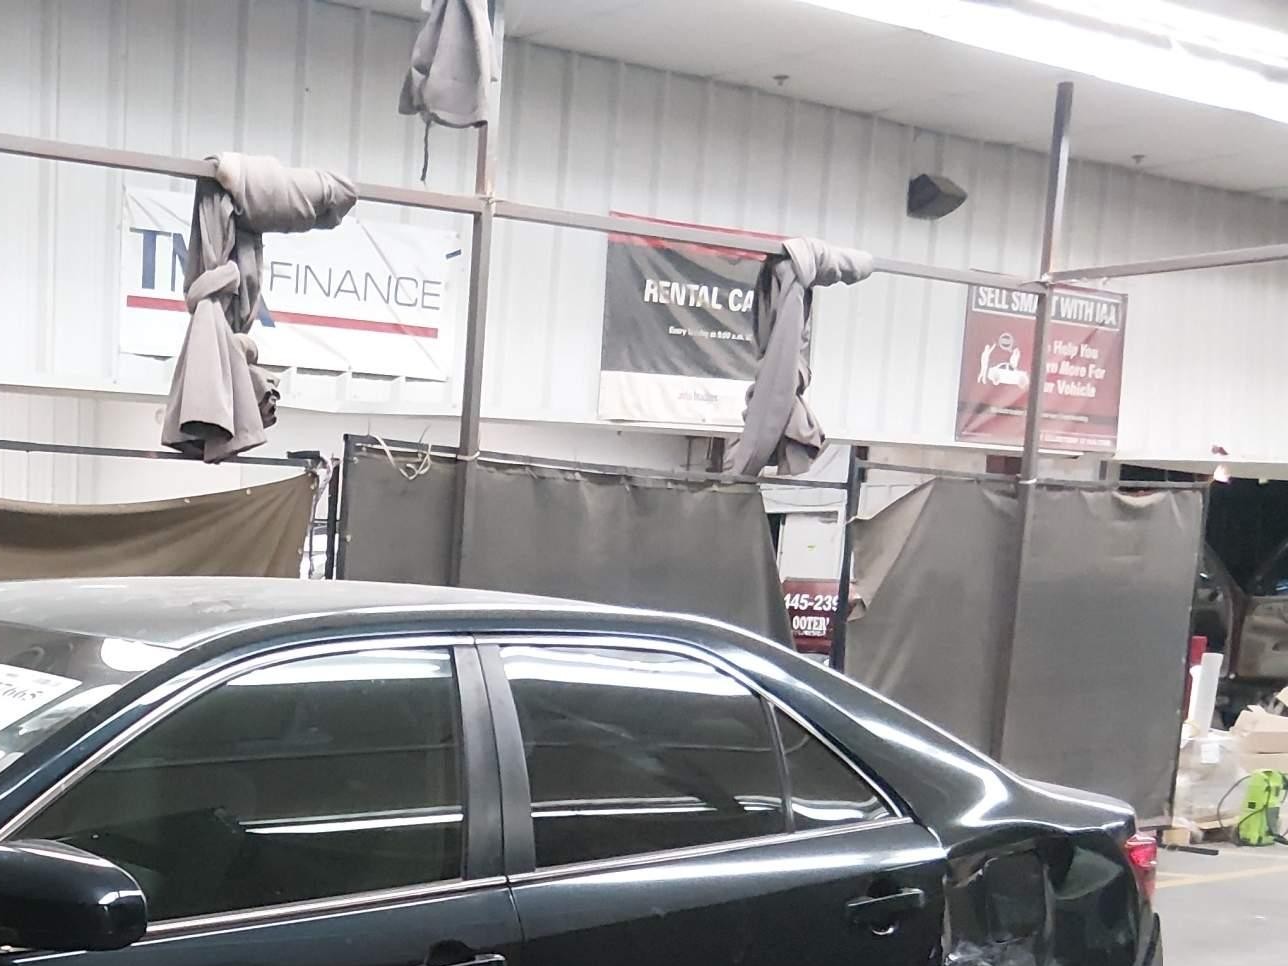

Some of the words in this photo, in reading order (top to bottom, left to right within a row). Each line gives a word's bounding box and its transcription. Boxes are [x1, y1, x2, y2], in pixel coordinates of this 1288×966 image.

[269, 260, 442, 311] FINANCE
[643, 279, 723, 310] RENTAL
[728, 288, 755, 313] CA
[978, 286, 1009, 309] SELL
[1011, 291, 1059, 317] SMT
[1060, 296, 1095, 322] WITH
[1053, 340, 1078, 359] Help
[1080, 343, 1099, 360] You
[1088, 364, 1106, 380] For
[1056, 379, 1096, 398] Vehicle
